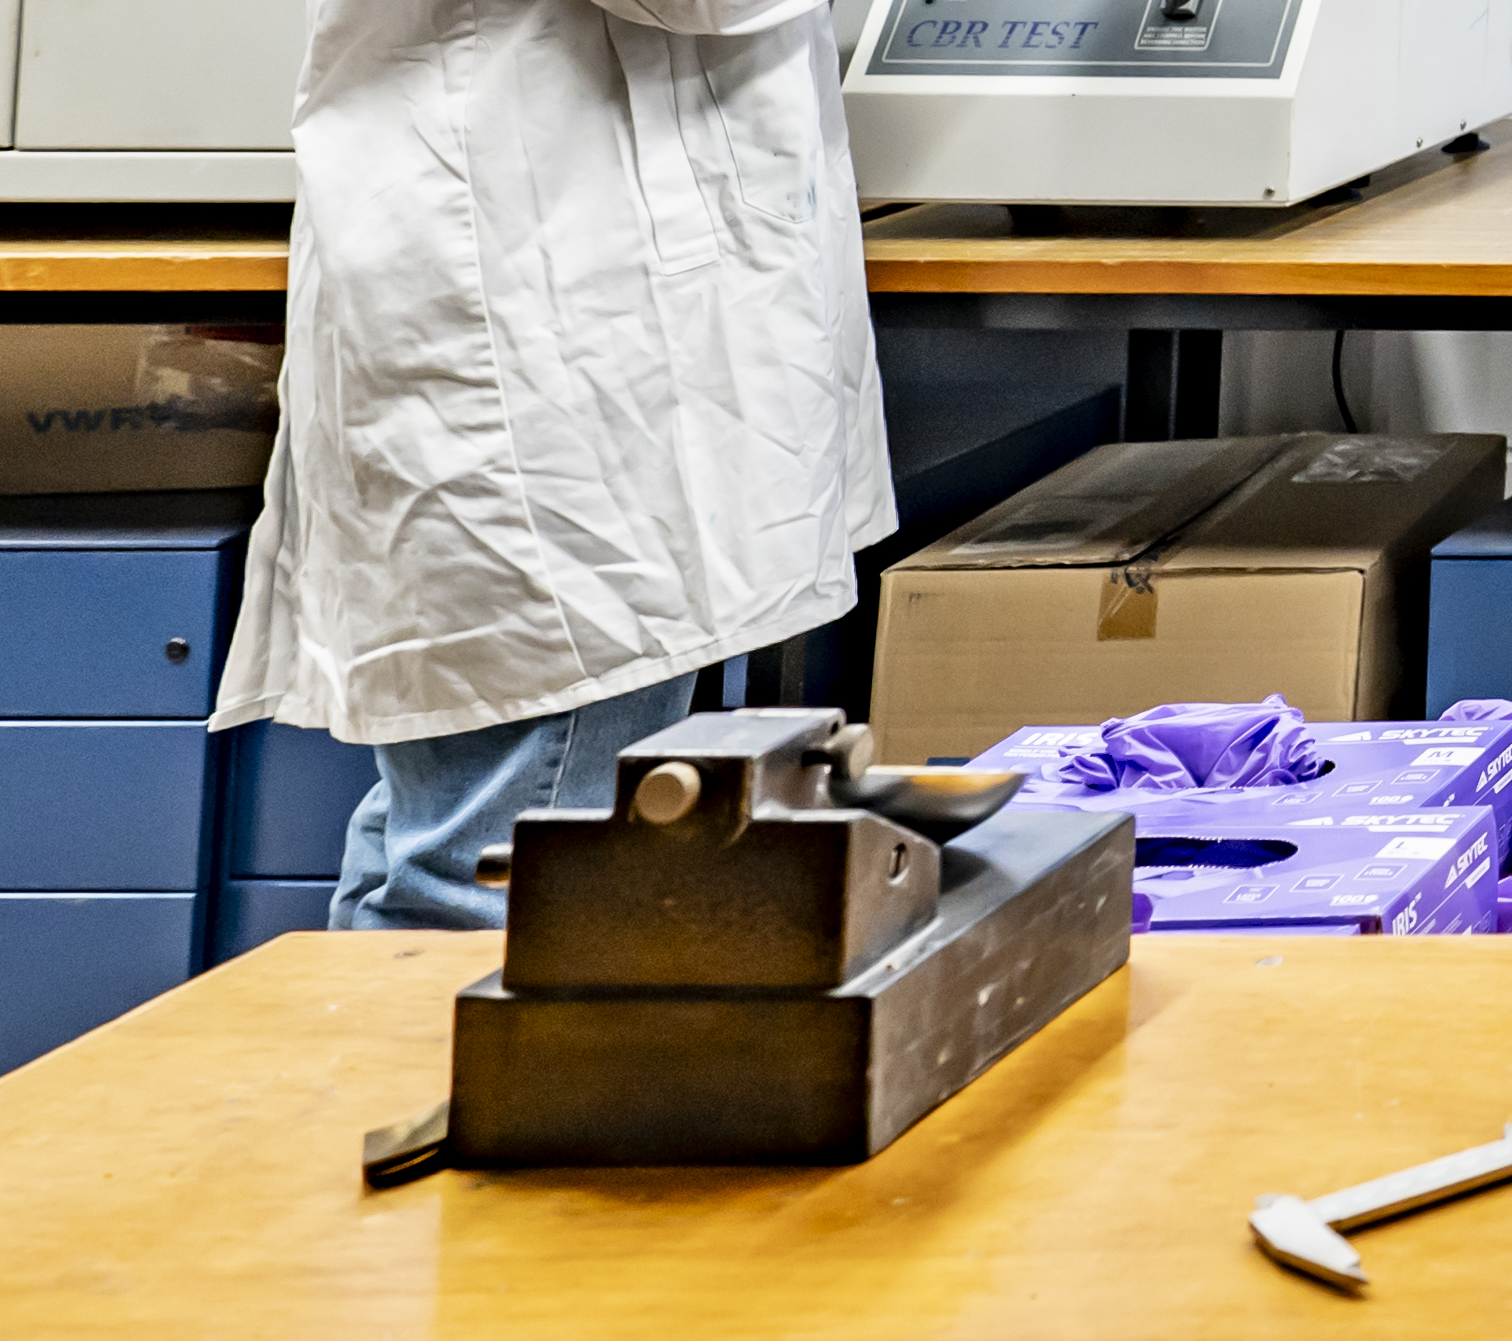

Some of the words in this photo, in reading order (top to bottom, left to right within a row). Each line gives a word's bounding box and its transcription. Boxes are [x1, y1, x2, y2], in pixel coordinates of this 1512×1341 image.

[907, 20, 989, 48] CBR
[997, 21, 1099, 49] TEST
[1021, 732, 1099, 746] IRIS
[1378, 726, 1489, 740] SKYTEC
[1430, 750, 1455, 758] M
[1341, 814, 1462, 826] SKYTEC
[1457, 831, 1488, 875] SKYTEC
